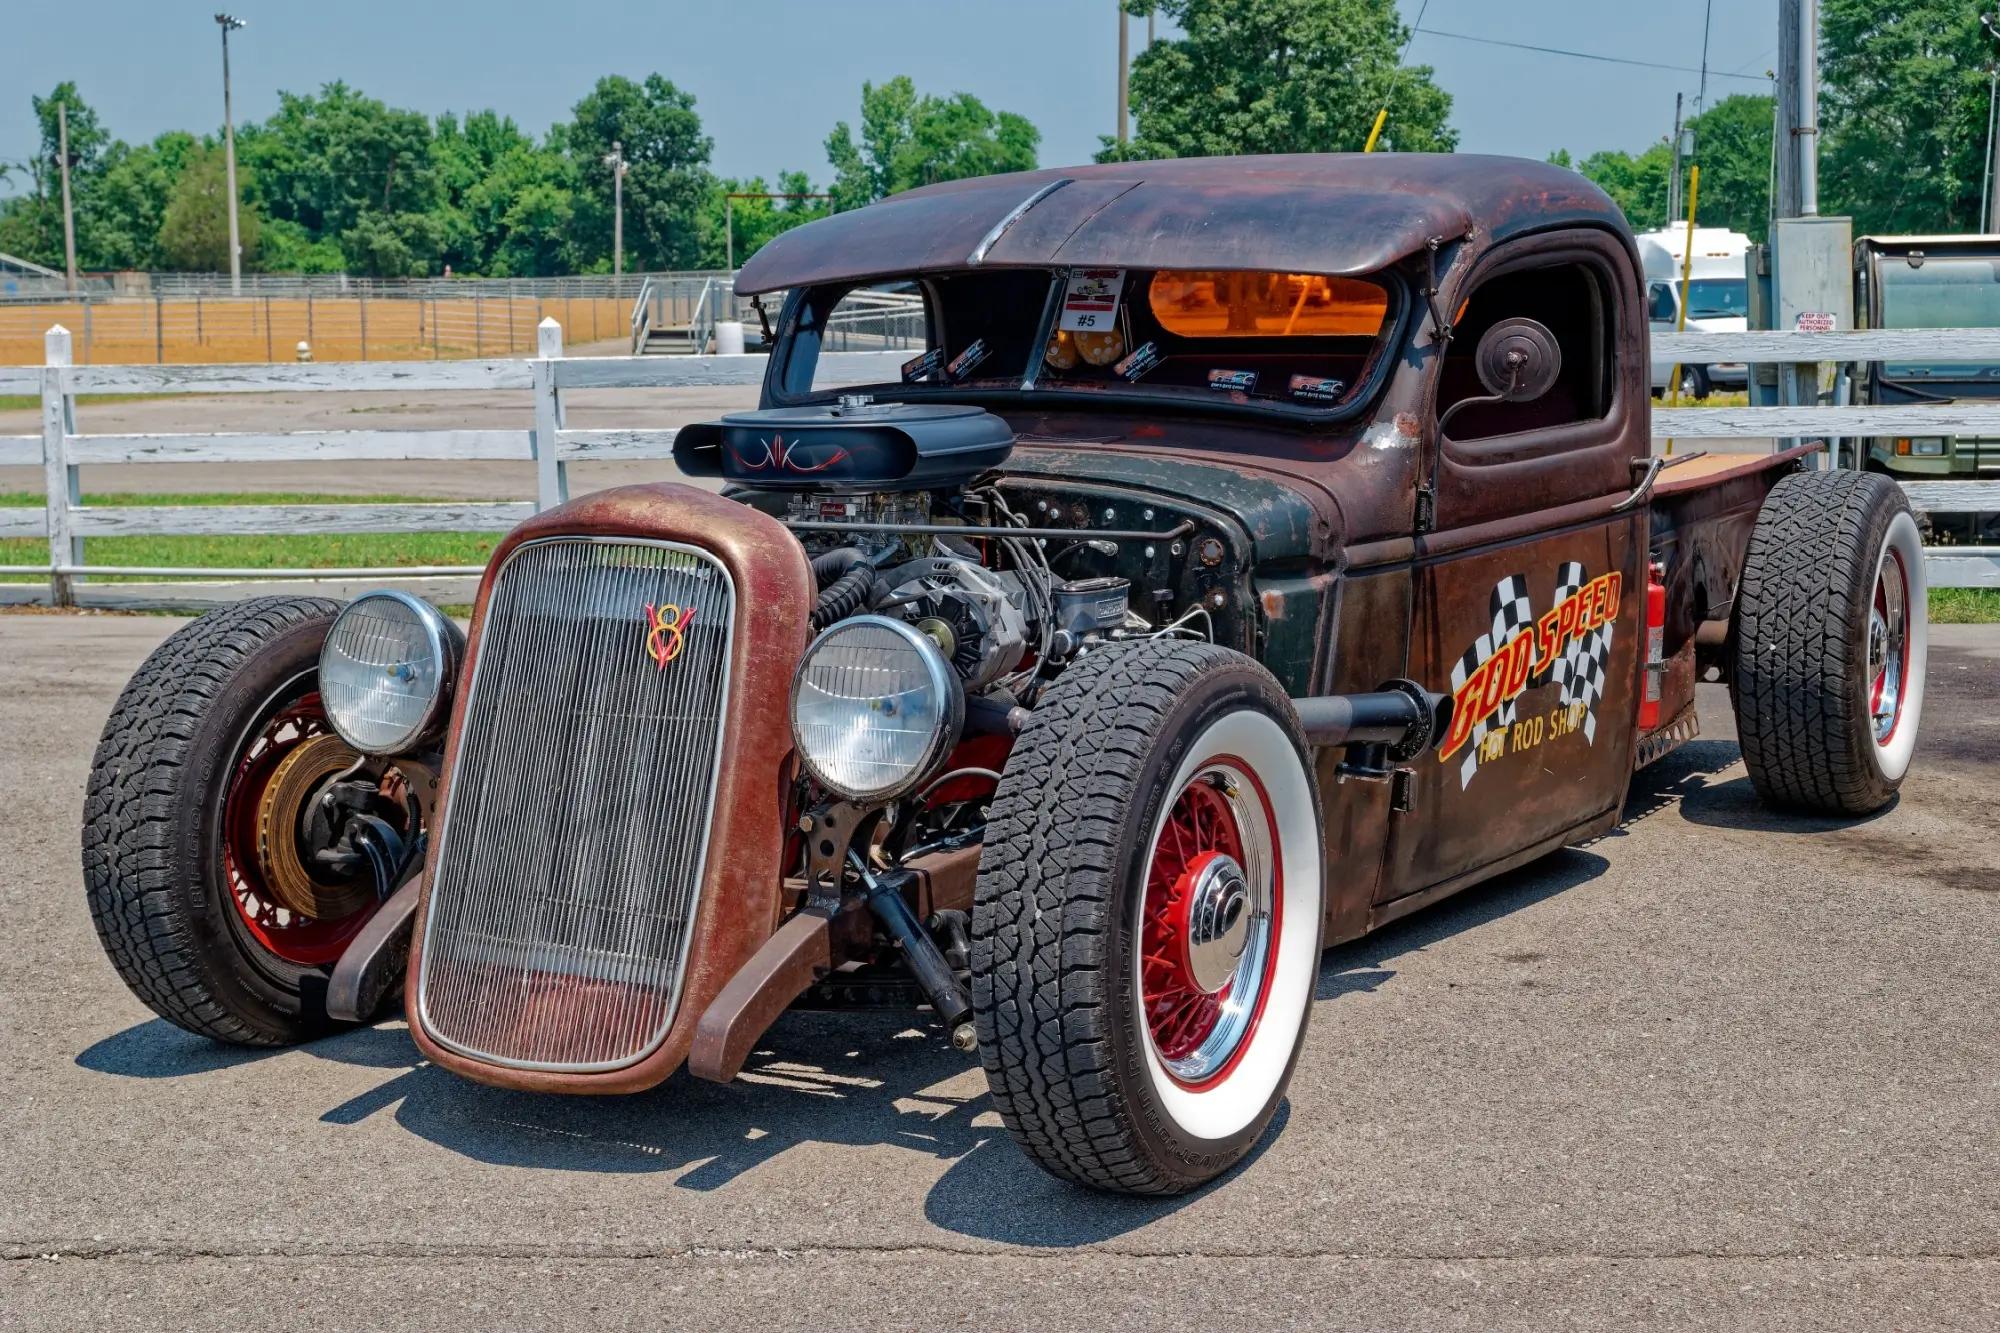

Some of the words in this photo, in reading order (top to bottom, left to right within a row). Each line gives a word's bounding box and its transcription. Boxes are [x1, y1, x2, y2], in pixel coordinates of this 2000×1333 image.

[1077, 314, 1096, 327] #5
[1478, 726, 1509, 765] HOT
[1512, 715, 1544, 753] ROD
[1548, 702, 1586, 741] SHOP
[1117, 929, 1140, 1078] Radial
